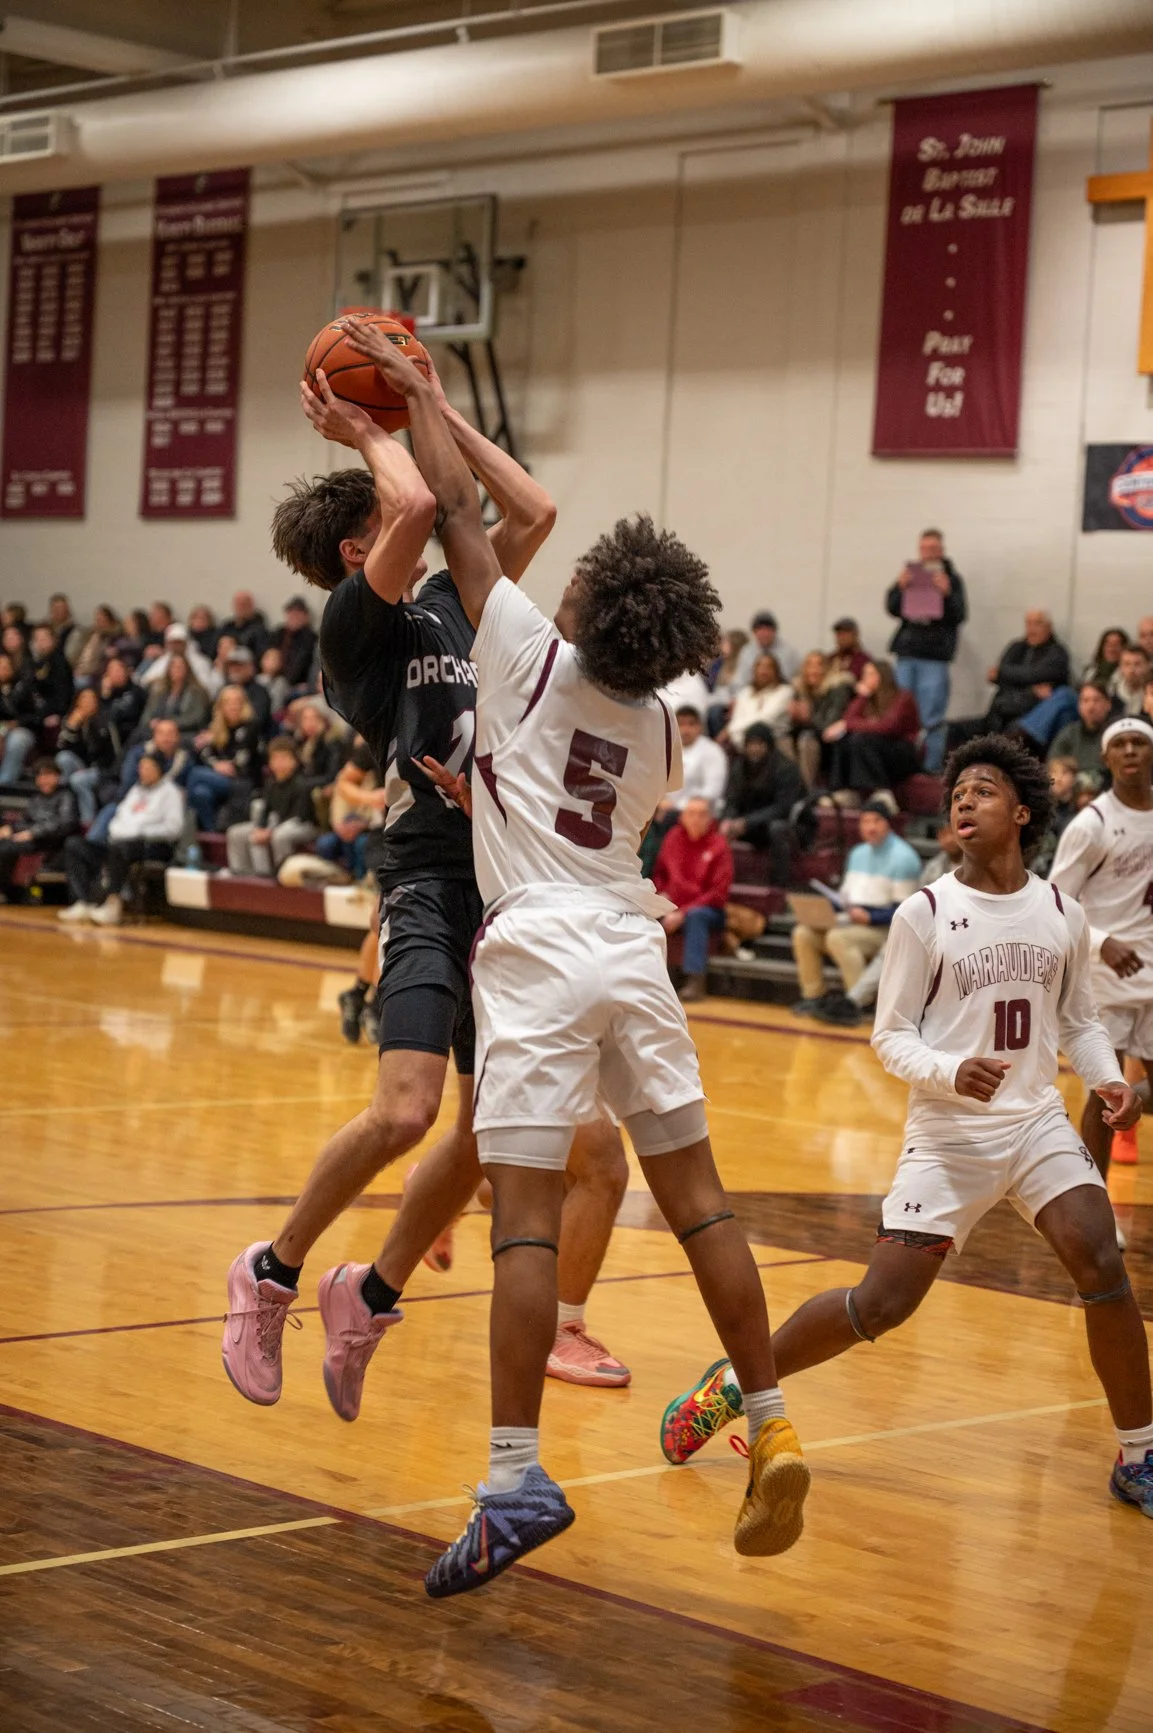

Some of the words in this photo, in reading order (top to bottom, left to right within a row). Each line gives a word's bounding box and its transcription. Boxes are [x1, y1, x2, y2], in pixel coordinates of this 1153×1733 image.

[554, 728, 629, 850] 5
[952, 943, 1058, 1001] MARAUDERS
[994, 998, 1031, 1051] 10
